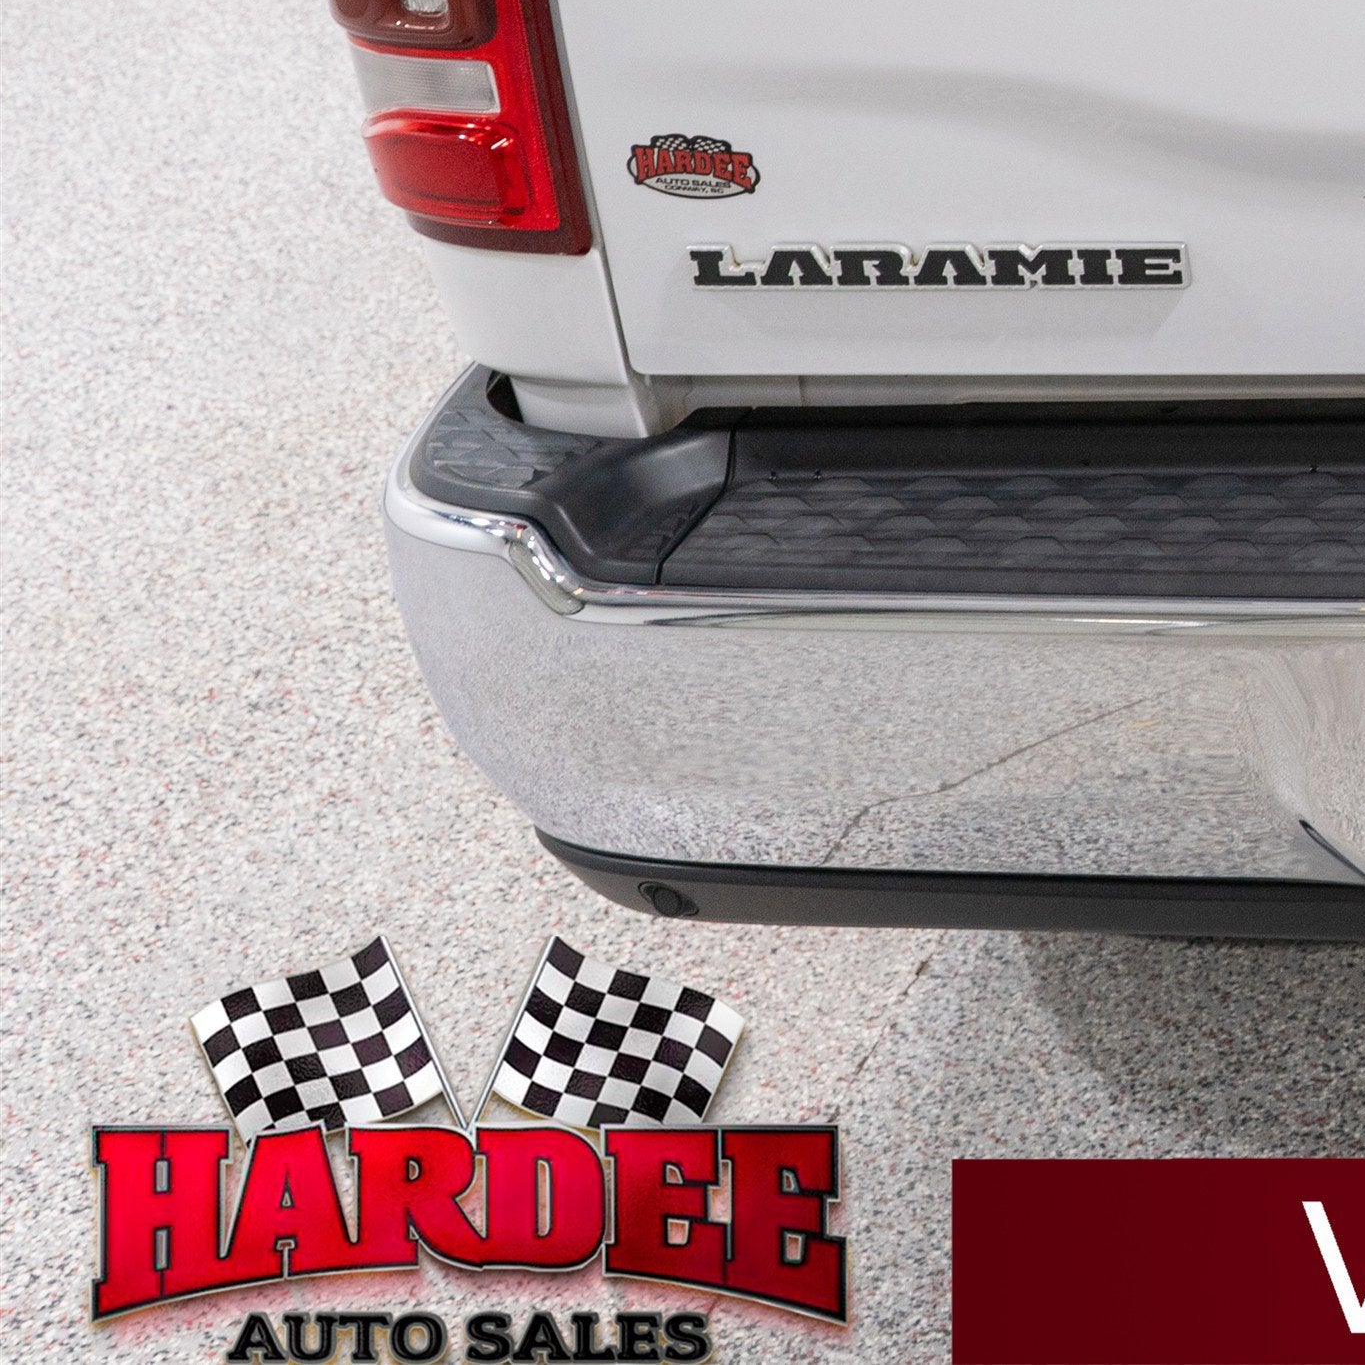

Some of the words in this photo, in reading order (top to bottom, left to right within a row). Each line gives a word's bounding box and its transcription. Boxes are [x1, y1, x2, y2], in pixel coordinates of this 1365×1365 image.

[634, 145, 753, 191] HARDEE
[655, 177, 690, 187] AUTO
[691, 179, 731, 189] SALES
[687, 242, 1191, 289] LARAMIE
